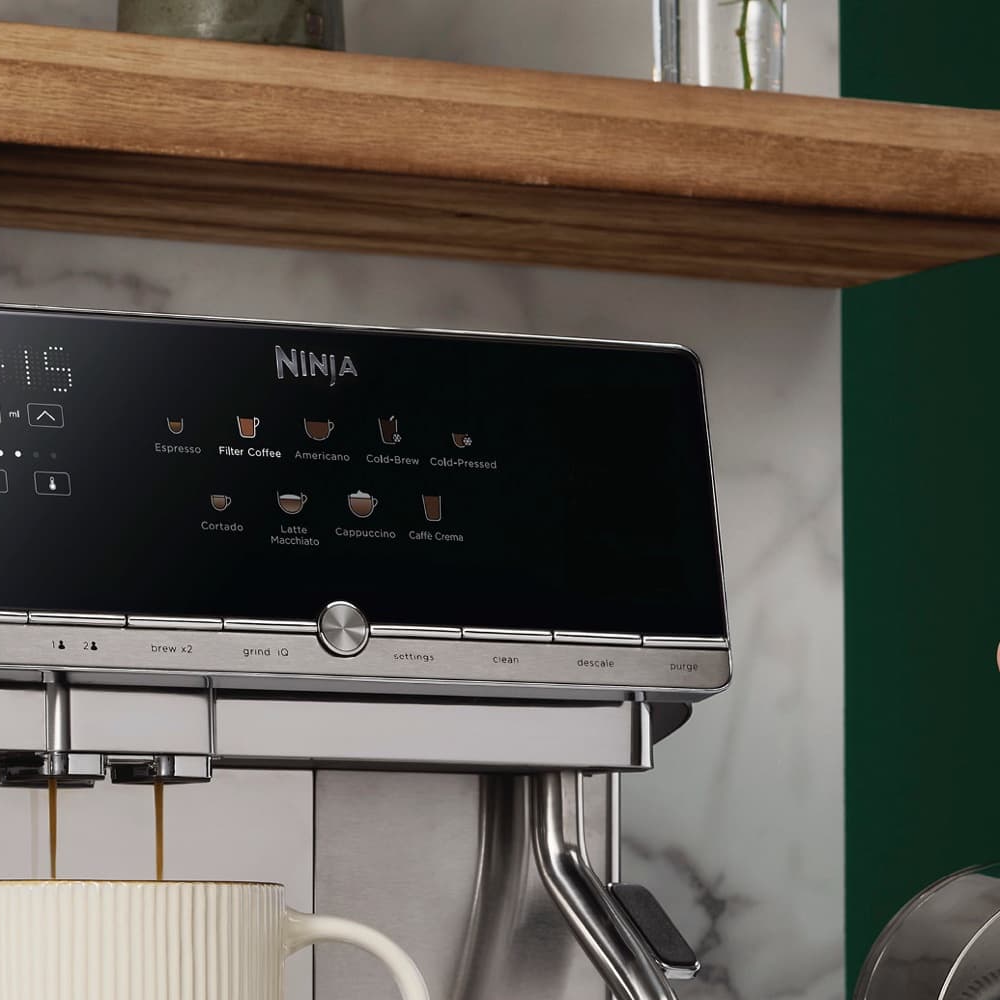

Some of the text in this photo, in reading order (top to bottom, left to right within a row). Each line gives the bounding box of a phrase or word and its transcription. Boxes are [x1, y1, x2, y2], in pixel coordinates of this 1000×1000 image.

[8, 409, 21, 418] ml
[154, 442, 202, 454] Espresso
[218, 445, 282, 459] Filter Coffee
[294, 450, 351, 462] Americano
[366, 453, 420, 466] Cold-Brew
[429, 456, 497, 470] Cold-Pressed
[200, 520, 244, 533] Cortado
[280, 524, 308, 535] Latte
[335, 526, 397, 540] Cappuccino
[434, 532, 464, 543] Crema
[270, 535, 320, 547] Macchiato
[151, 643, 194, 655] brew x2
[242, 646, 271, 659] grind
[393, 652, 435, 664] settings
[492, 655, 520, 665] clean
[577, 658, 616, 669] descale
[670, 662, 700, 673] purge
